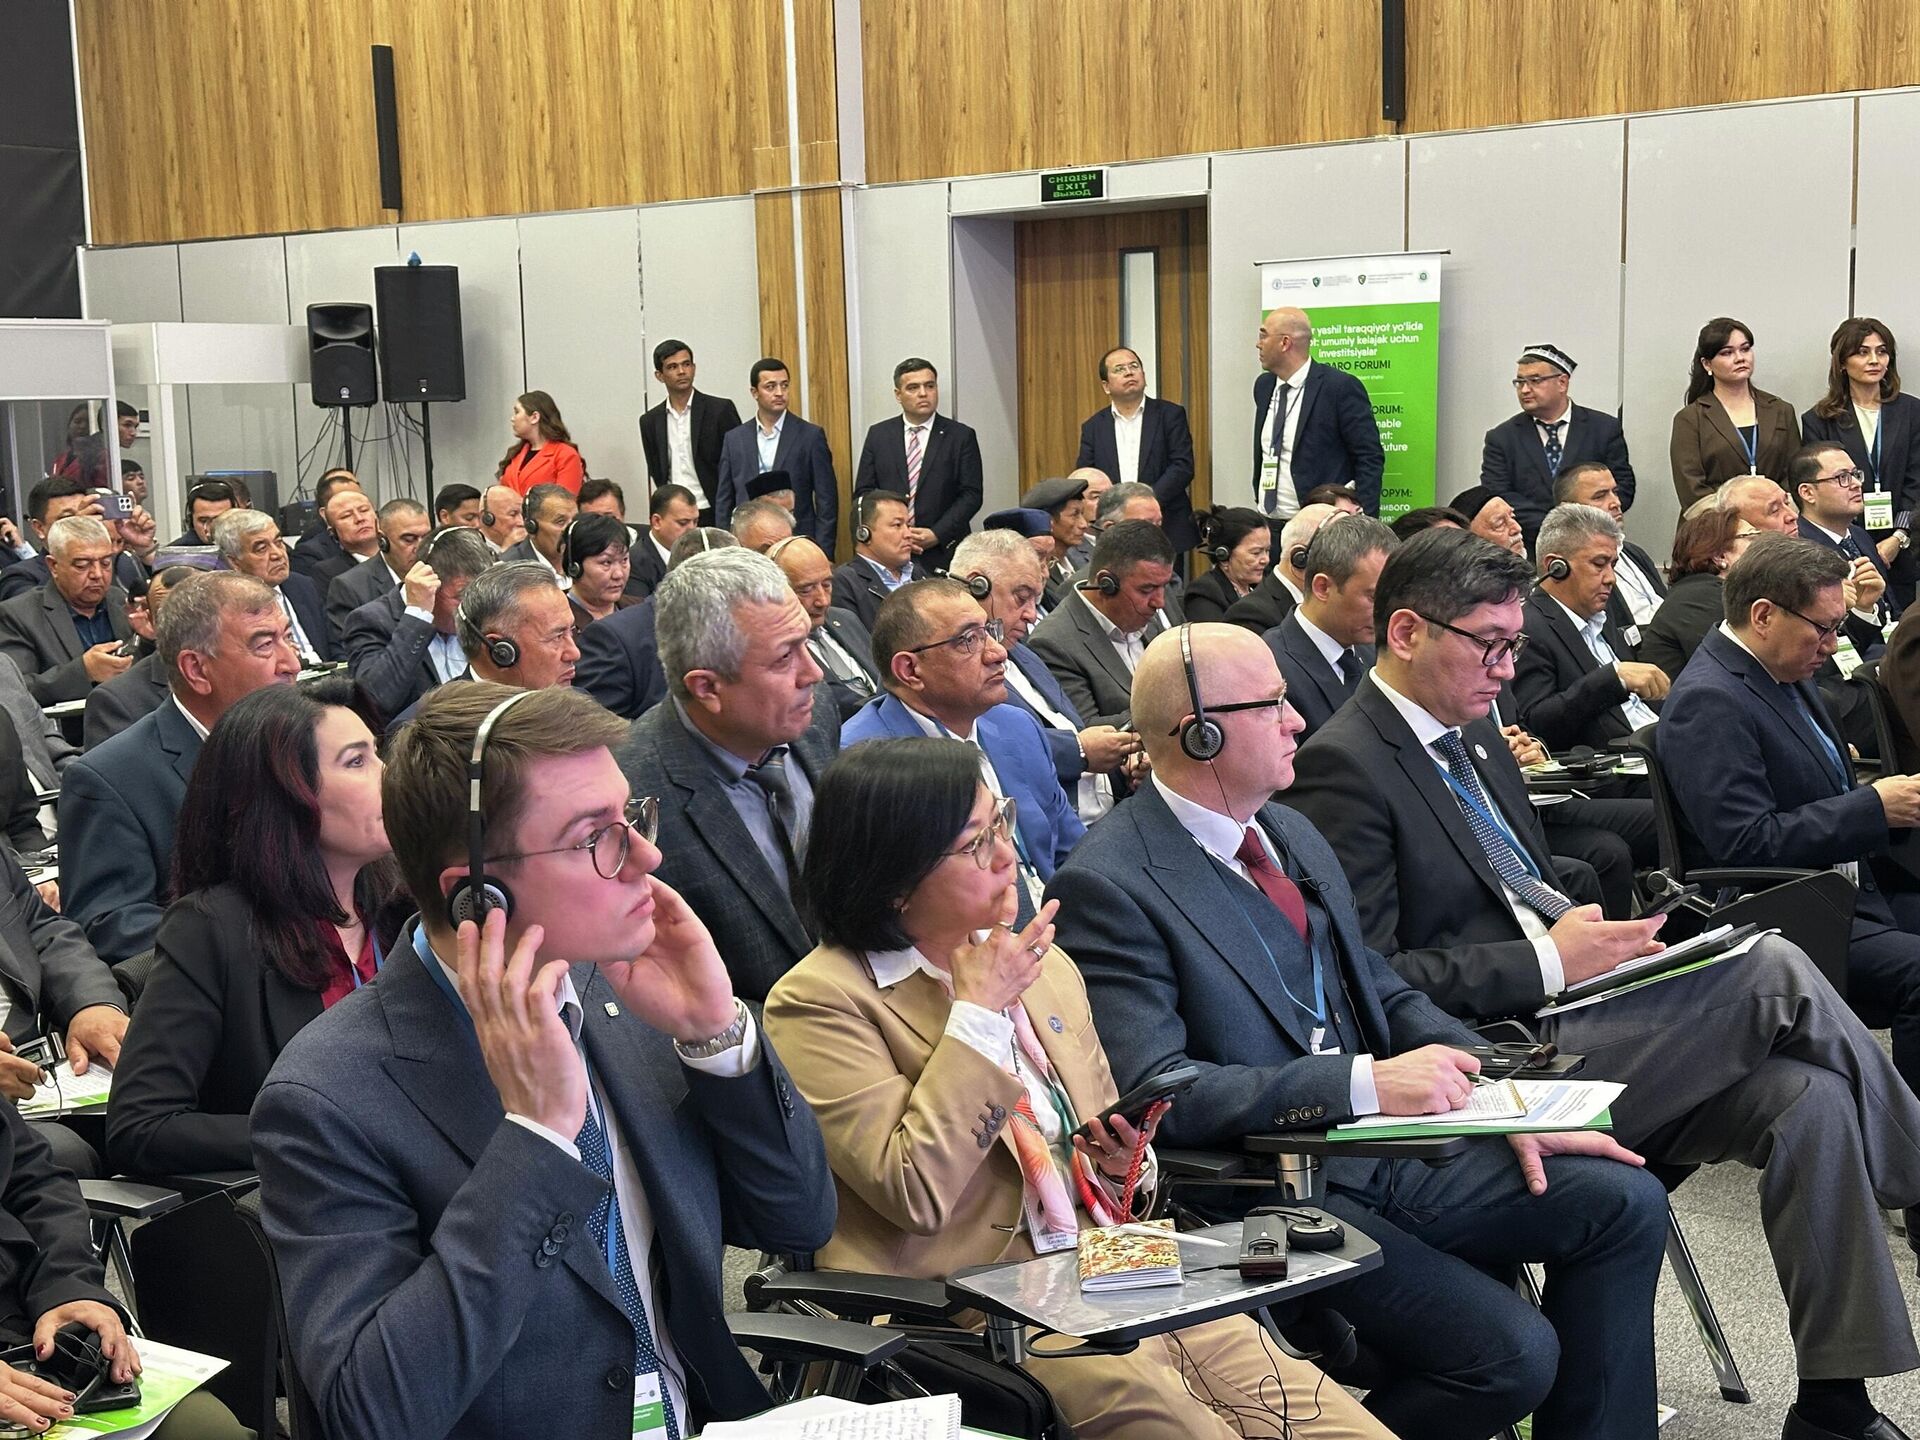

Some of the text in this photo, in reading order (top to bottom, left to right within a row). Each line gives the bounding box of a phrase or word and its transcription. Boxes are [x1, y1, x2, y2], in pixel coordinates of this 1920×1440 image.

[1048, 173, 1096, 184] CHIQISH
[1056, 182, 1088, 191] EXIT
[1053, 189, 1091, 198] ВЫХОД
[1316, 324, 1342, 337] yashil
[1343, 322, 1391, 335] taraqqiyot
[1321, 335, 1355, 347] umumiy
[1356, 335, 1388, 346] kelajak
[1389, 333, 1419, 344] uchun
[1318, 347, 1378, 358] investitsiyalar
[1354, 360, 1391, 370] FORUMI
[1371, 404, 1404, 415] ORUM:
[1375, 418, 1402, 429] nable
[1380, 430, 1394, 440] nt:
[1381, 488, 1413, 498] ОРУМ:
